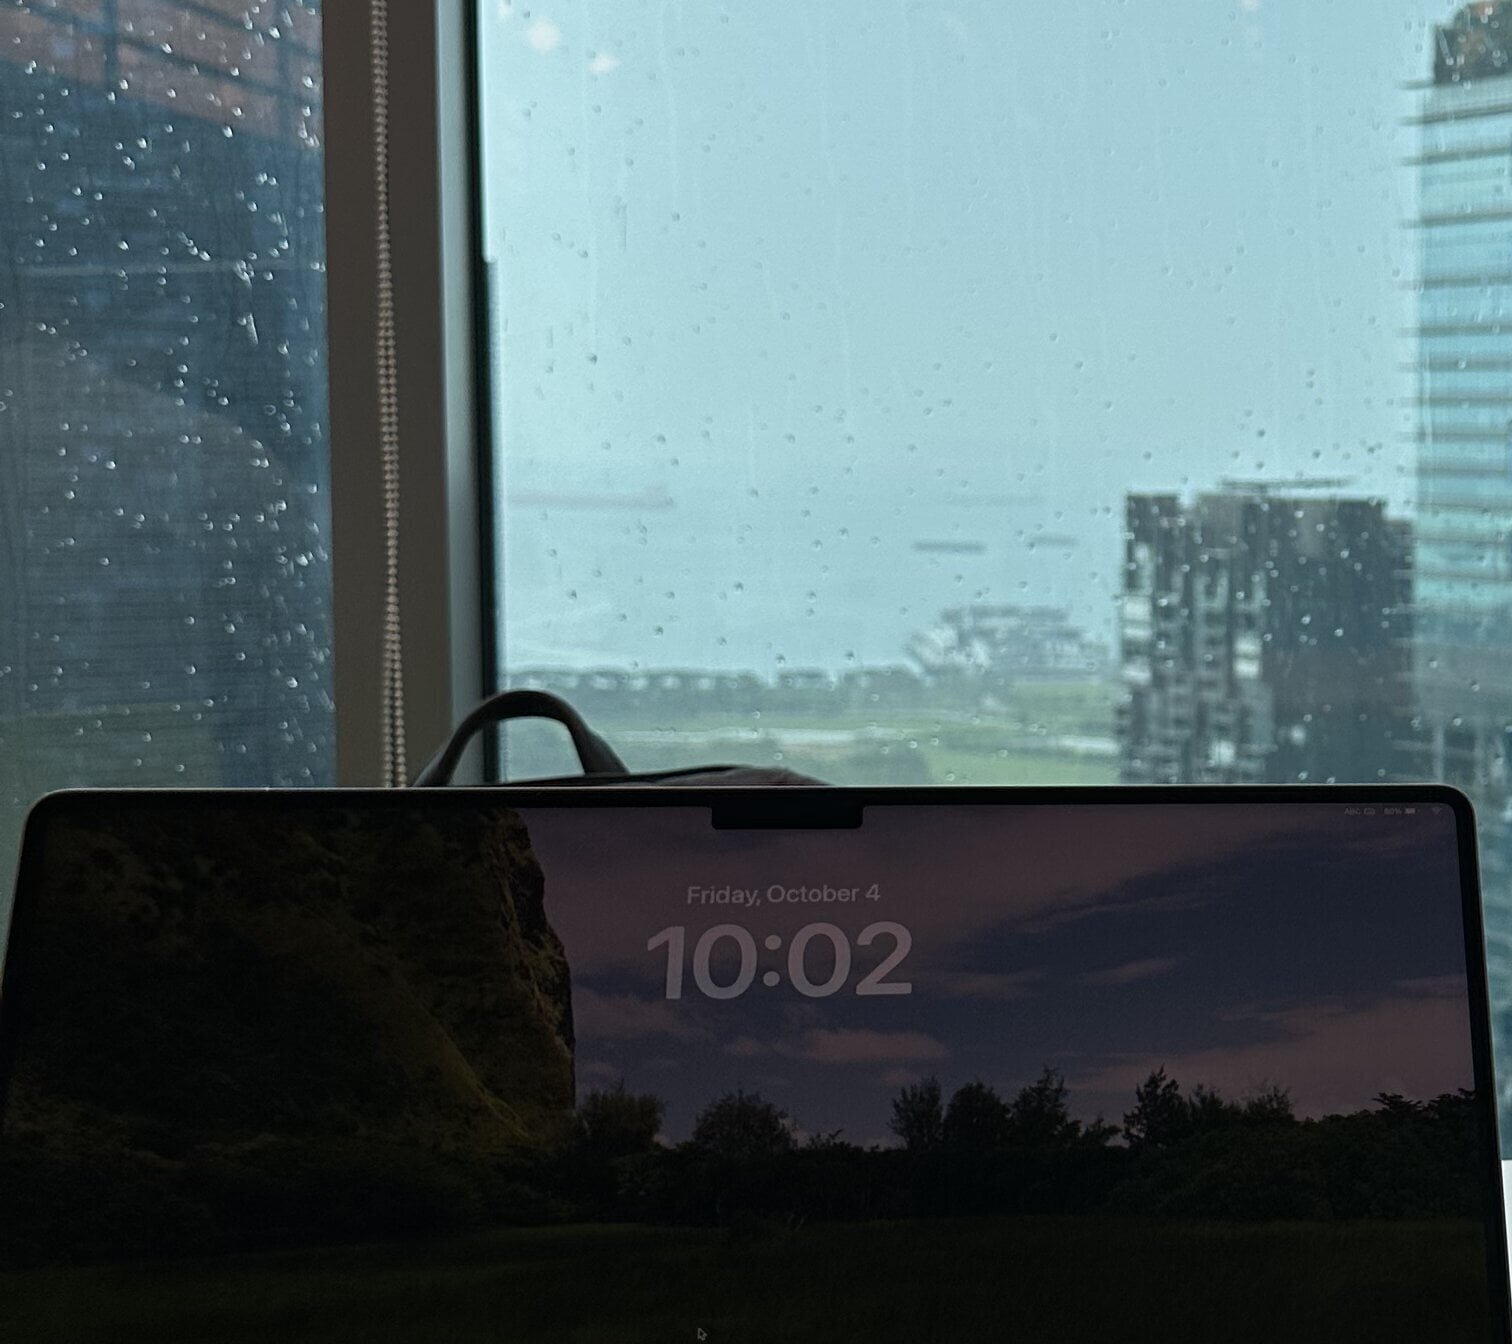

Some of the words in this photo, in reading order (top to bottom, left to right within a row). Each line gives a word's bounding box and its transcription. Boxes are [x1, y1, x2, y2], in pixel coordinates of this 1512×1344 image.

[687, 885, 761, 907] Friday,
[767, 884, 859, 903] October
[865, 884, 881, 902] 4
[647, 920, 913, 1000] 10:02
